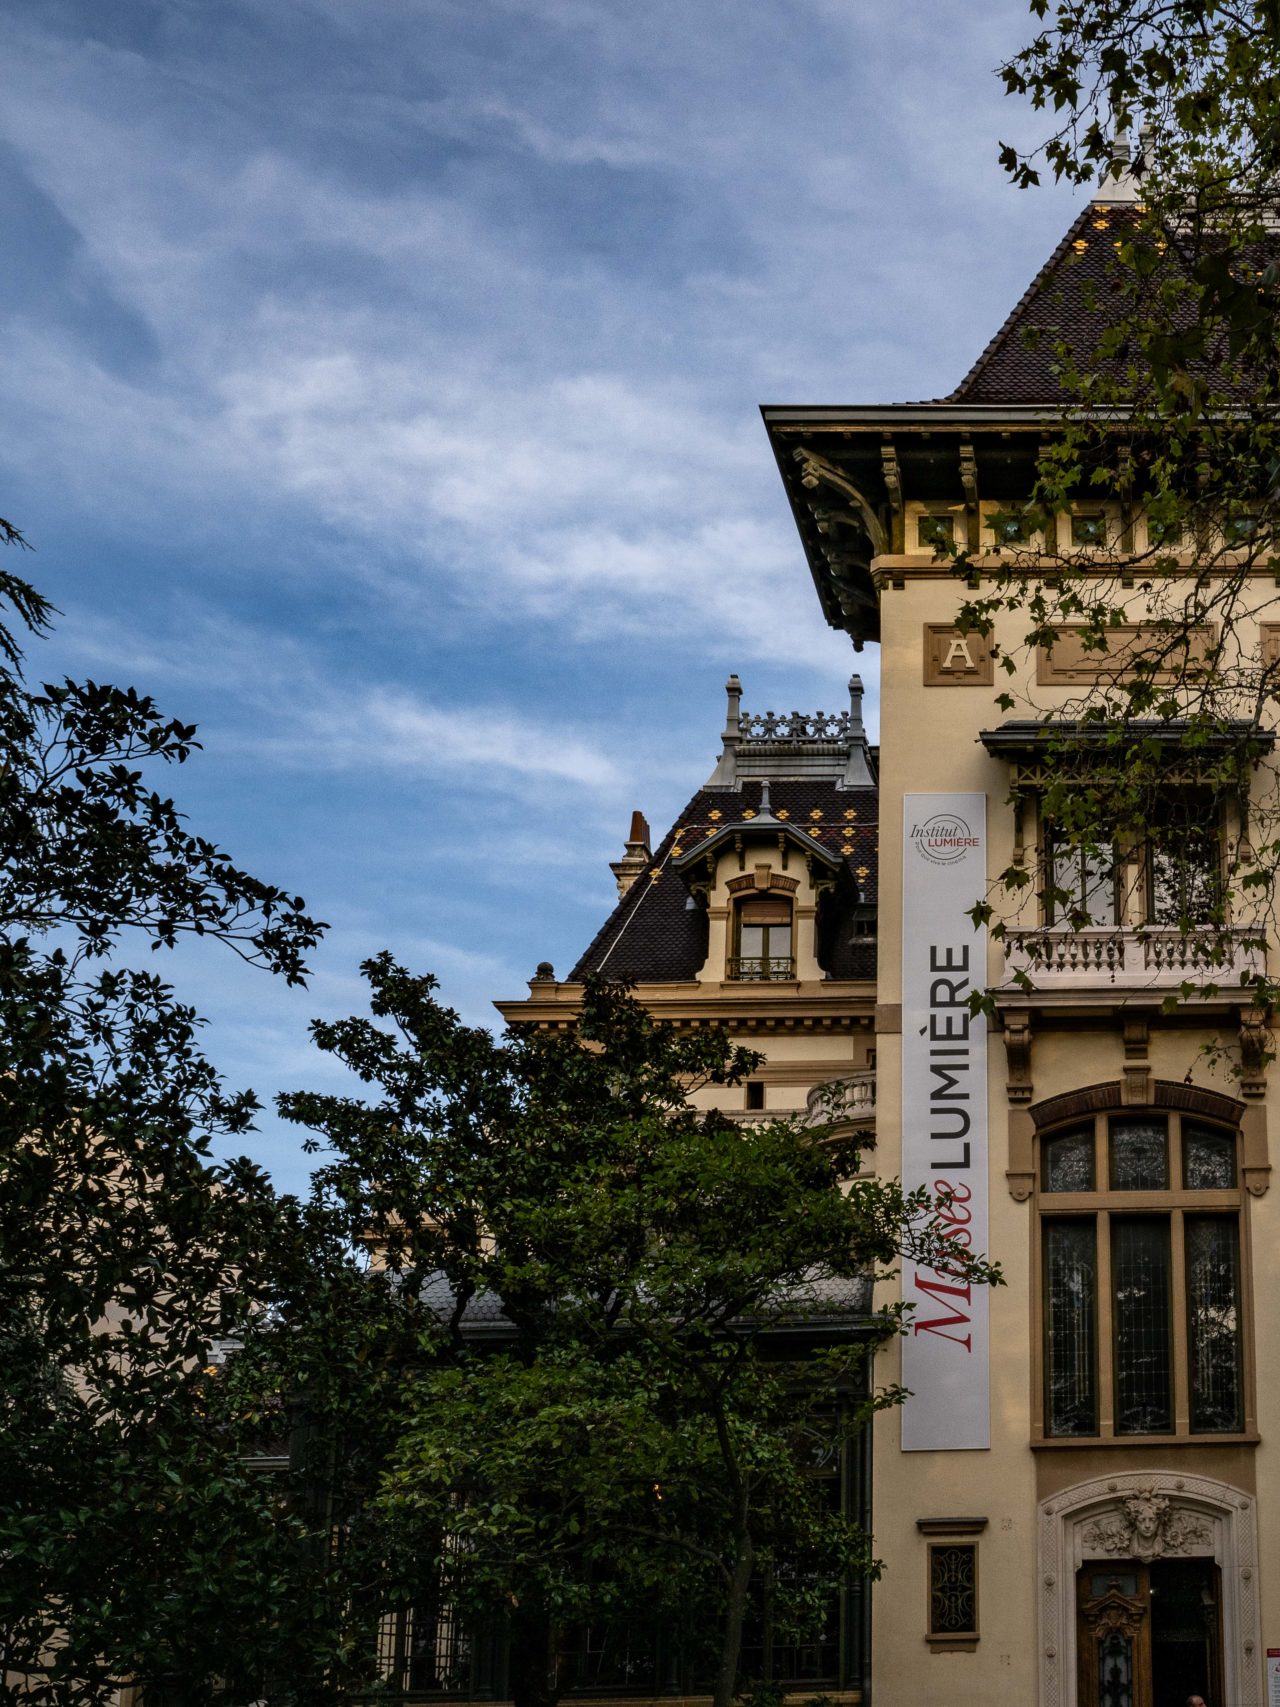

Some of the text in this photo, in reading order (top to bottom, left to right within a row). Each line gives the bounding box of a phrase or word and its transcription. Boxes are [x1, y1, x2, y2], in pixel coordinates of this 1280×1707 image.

[942, 639, 975, 668] A
[910, 824, 959, 838] Institut
[928, 836, 980, 847] LUMIÈRE
[918, 944, 972, 1170] LUMIÈRE
